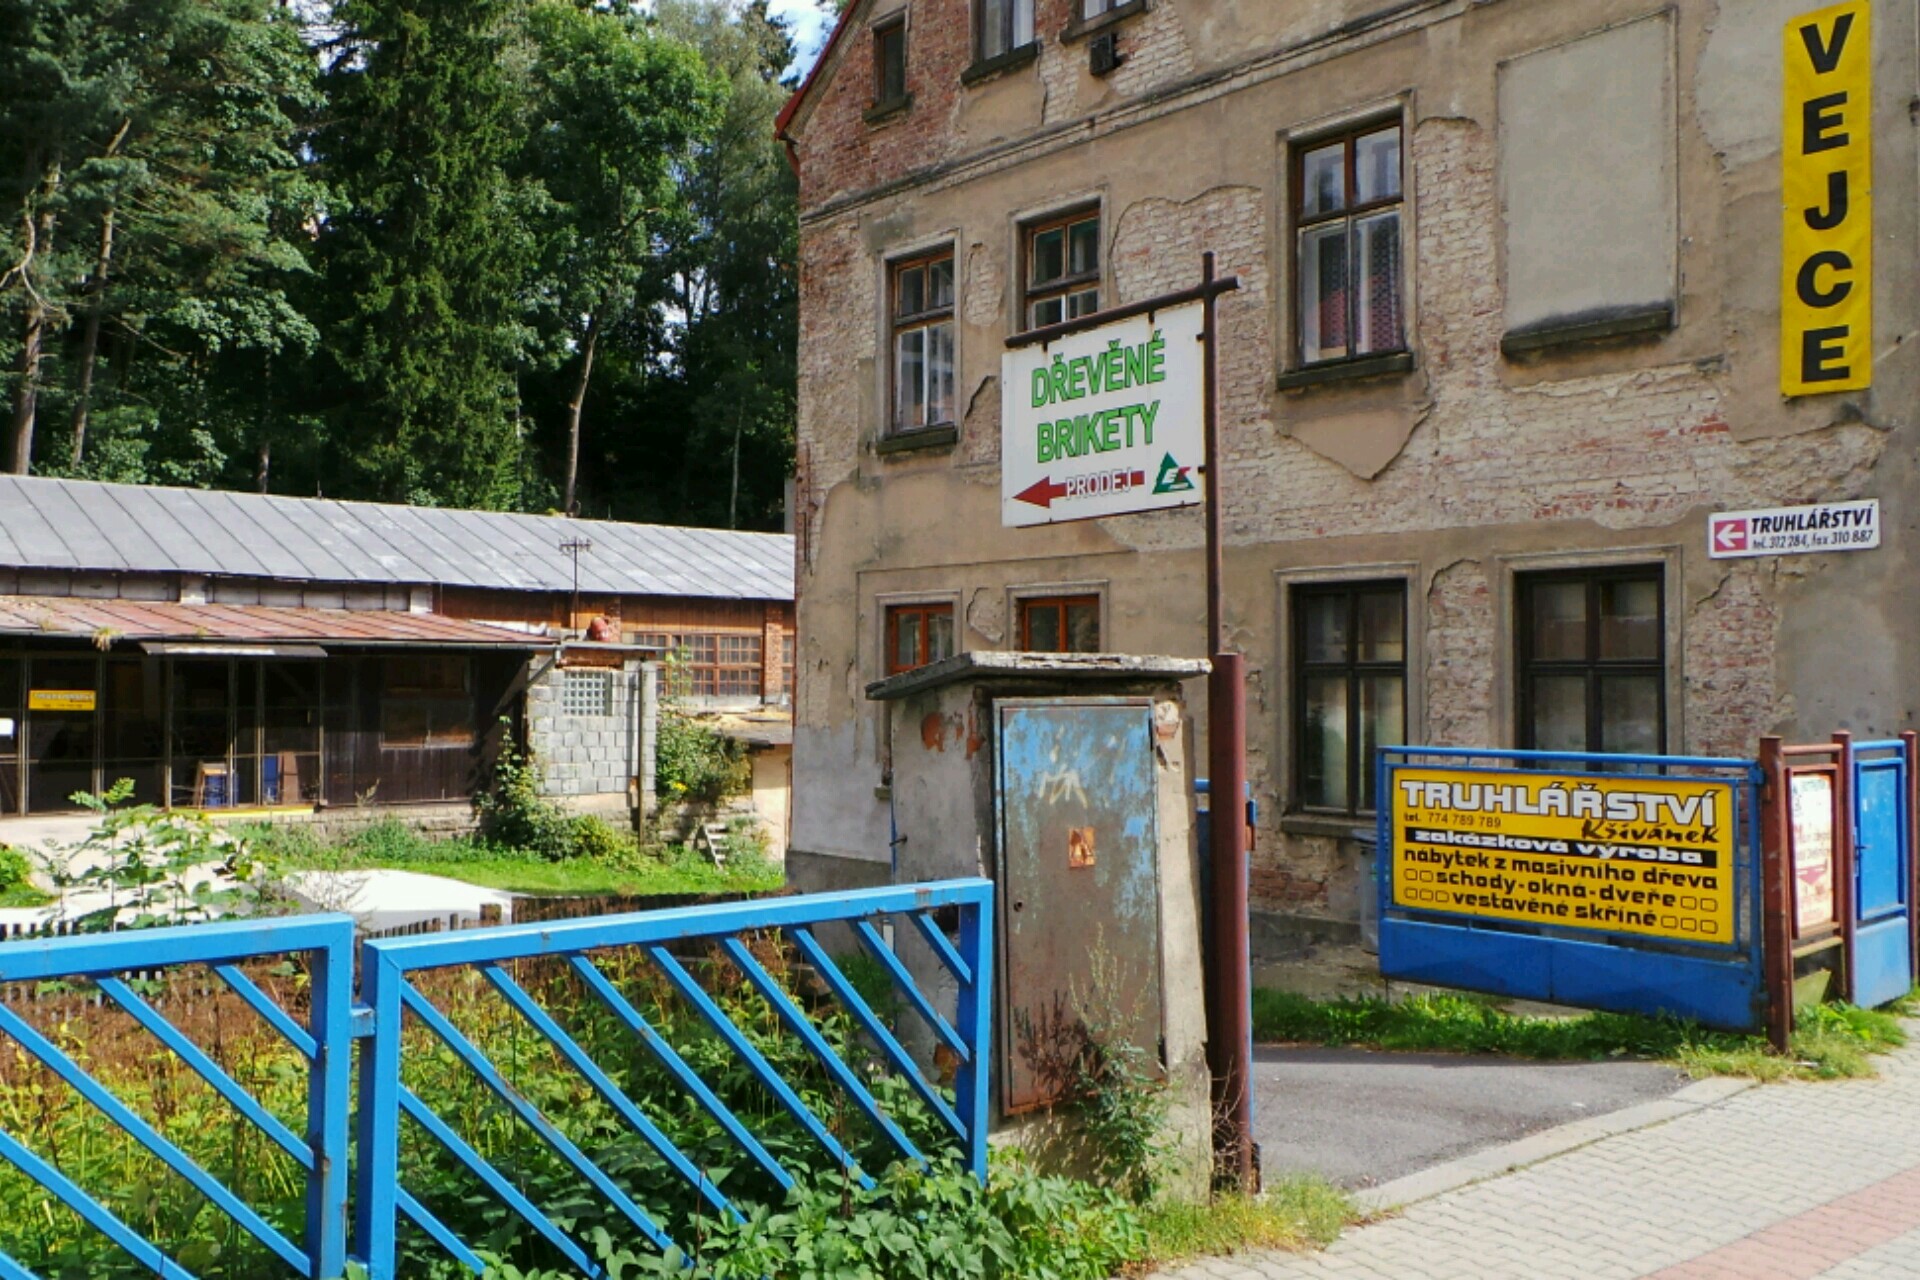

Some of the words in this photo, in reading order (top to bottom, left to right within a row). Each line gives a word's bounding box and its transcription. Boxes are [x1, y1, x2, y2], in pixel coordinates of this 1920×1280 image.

[1796, 12, 1856, 382] VEJCE
[1031, 328, 1167, 409] DŘEVĚNÉ
[1037, 400, 1161, 464] BRIKETY
[1065, 467, 1132, 501] PRODEJ
[1751, 503, 1874, 535] TRUHLÁŘSTVÍ
[1811, 533, 1828, 546] fax
[1831, 531, 1849, 545] 310
[1400, 780, 1722, 828] TRUHLÁŘSTVÍ
[1404, 812, 1421, 822] tel.
[1427, 813, 1448, 823] 774
[1453, 815, 1474, 826] 789
[1479, 817, 1501, 828] 789
[1415, 830, 1569, 853] zakázková
[1576, 843, 1703, 864] výroba
[1404, 847, 1489, 869] nábytek
[1494, 857, 1507, 870] z
[1512, 858, 1636, 881] masivního
[1643, 867, 1718, 890] dřeva
[1452, 891, 1569, 916] vestavěné
[1575, 903, 1657, 928] skříně
